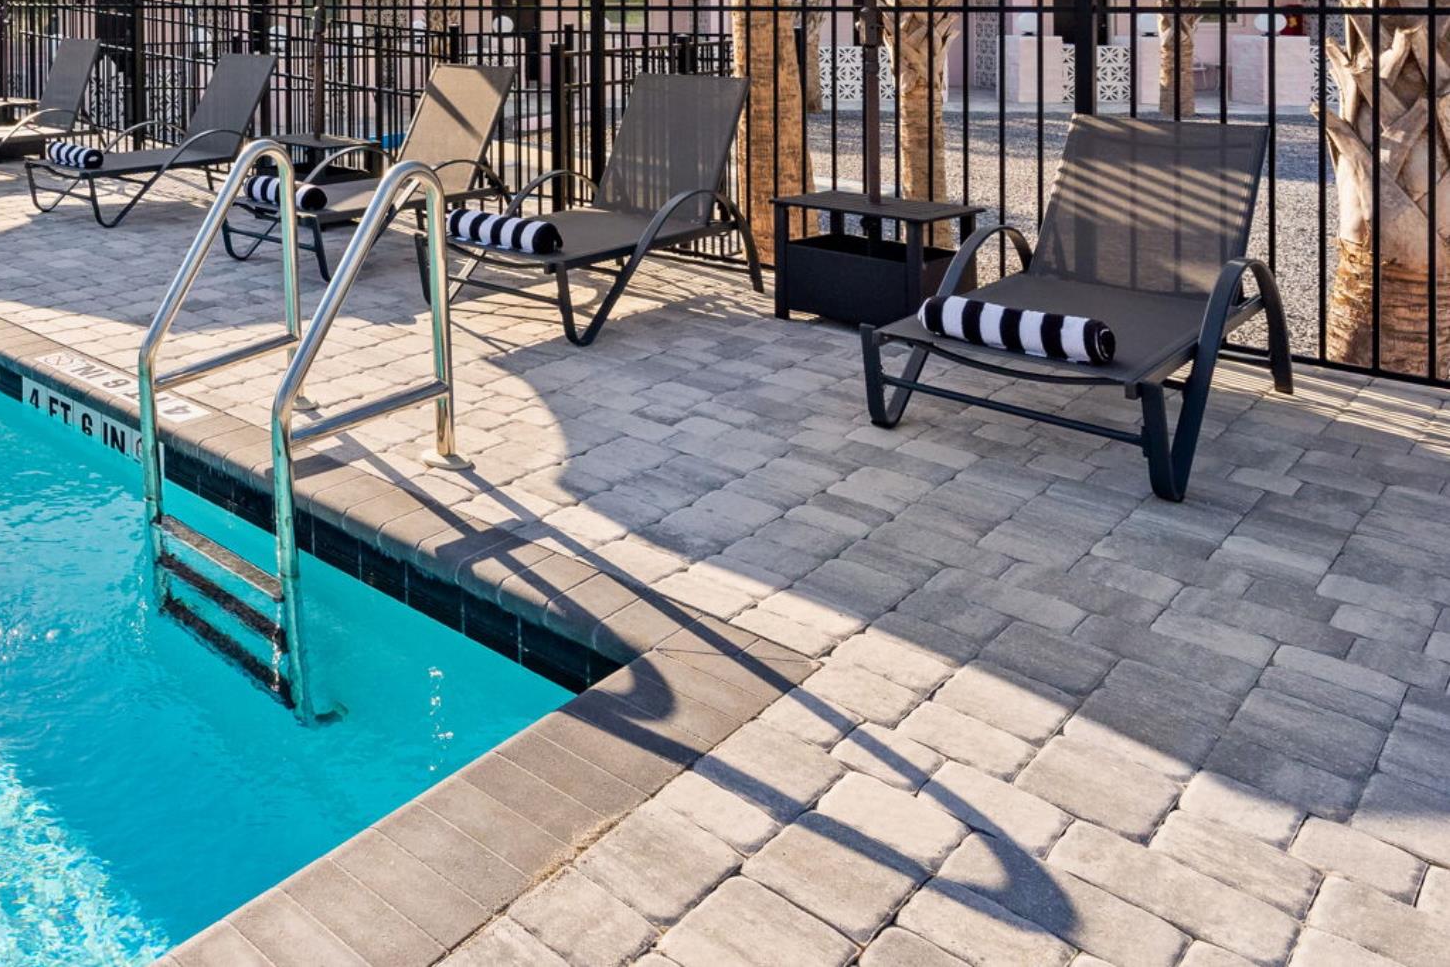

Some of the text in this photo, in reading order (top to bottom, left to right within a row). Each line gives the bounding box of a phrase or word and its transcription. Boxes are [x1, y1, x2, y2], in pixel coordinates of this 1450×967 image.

[30, 387, 40, 410] 4
[49, 395, 71, 425] FT
[81, 412, 93, 437] 6
